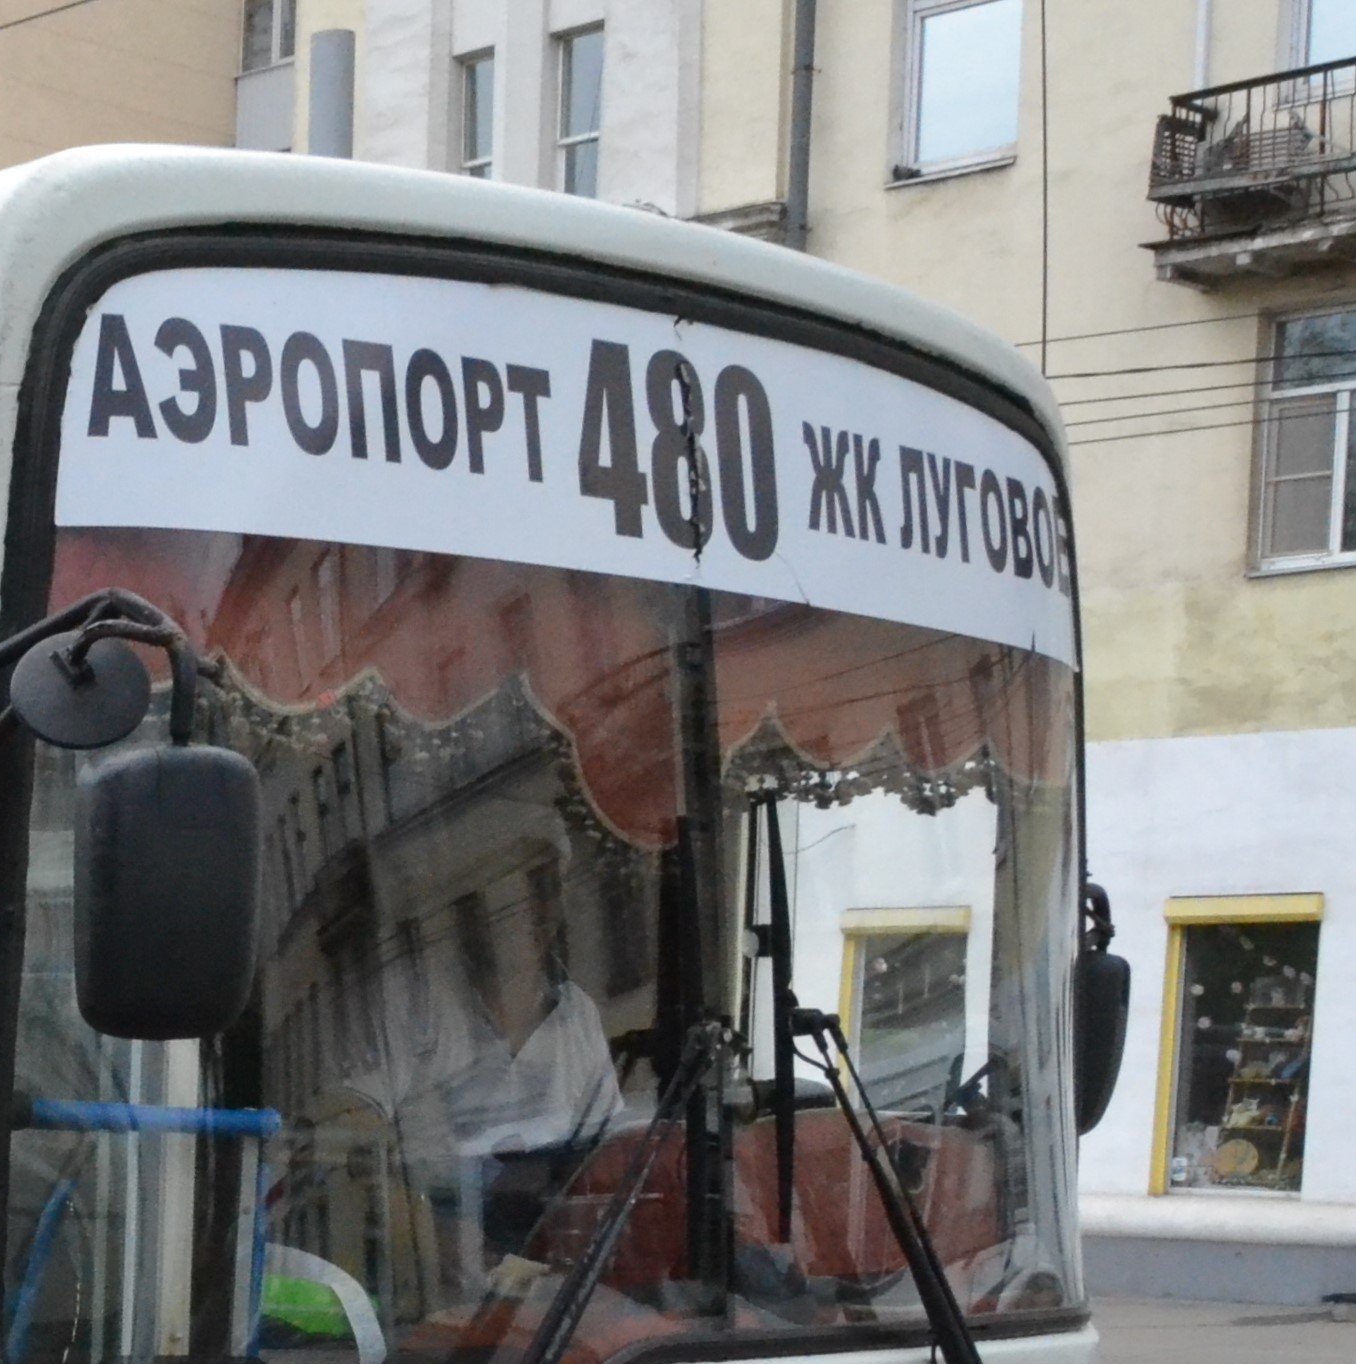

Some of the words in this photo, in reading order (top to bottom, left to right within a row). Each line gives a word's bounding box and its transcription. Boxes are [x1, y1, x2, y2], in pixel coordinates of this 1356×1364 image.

[87, 313, 551, 483] АЭРОПОРТ
[579, 338, 779, 562] 480
[802, 420, 888, 545] ЖК
[898, 448, 1071, 598] ЛУГОВОЕ
